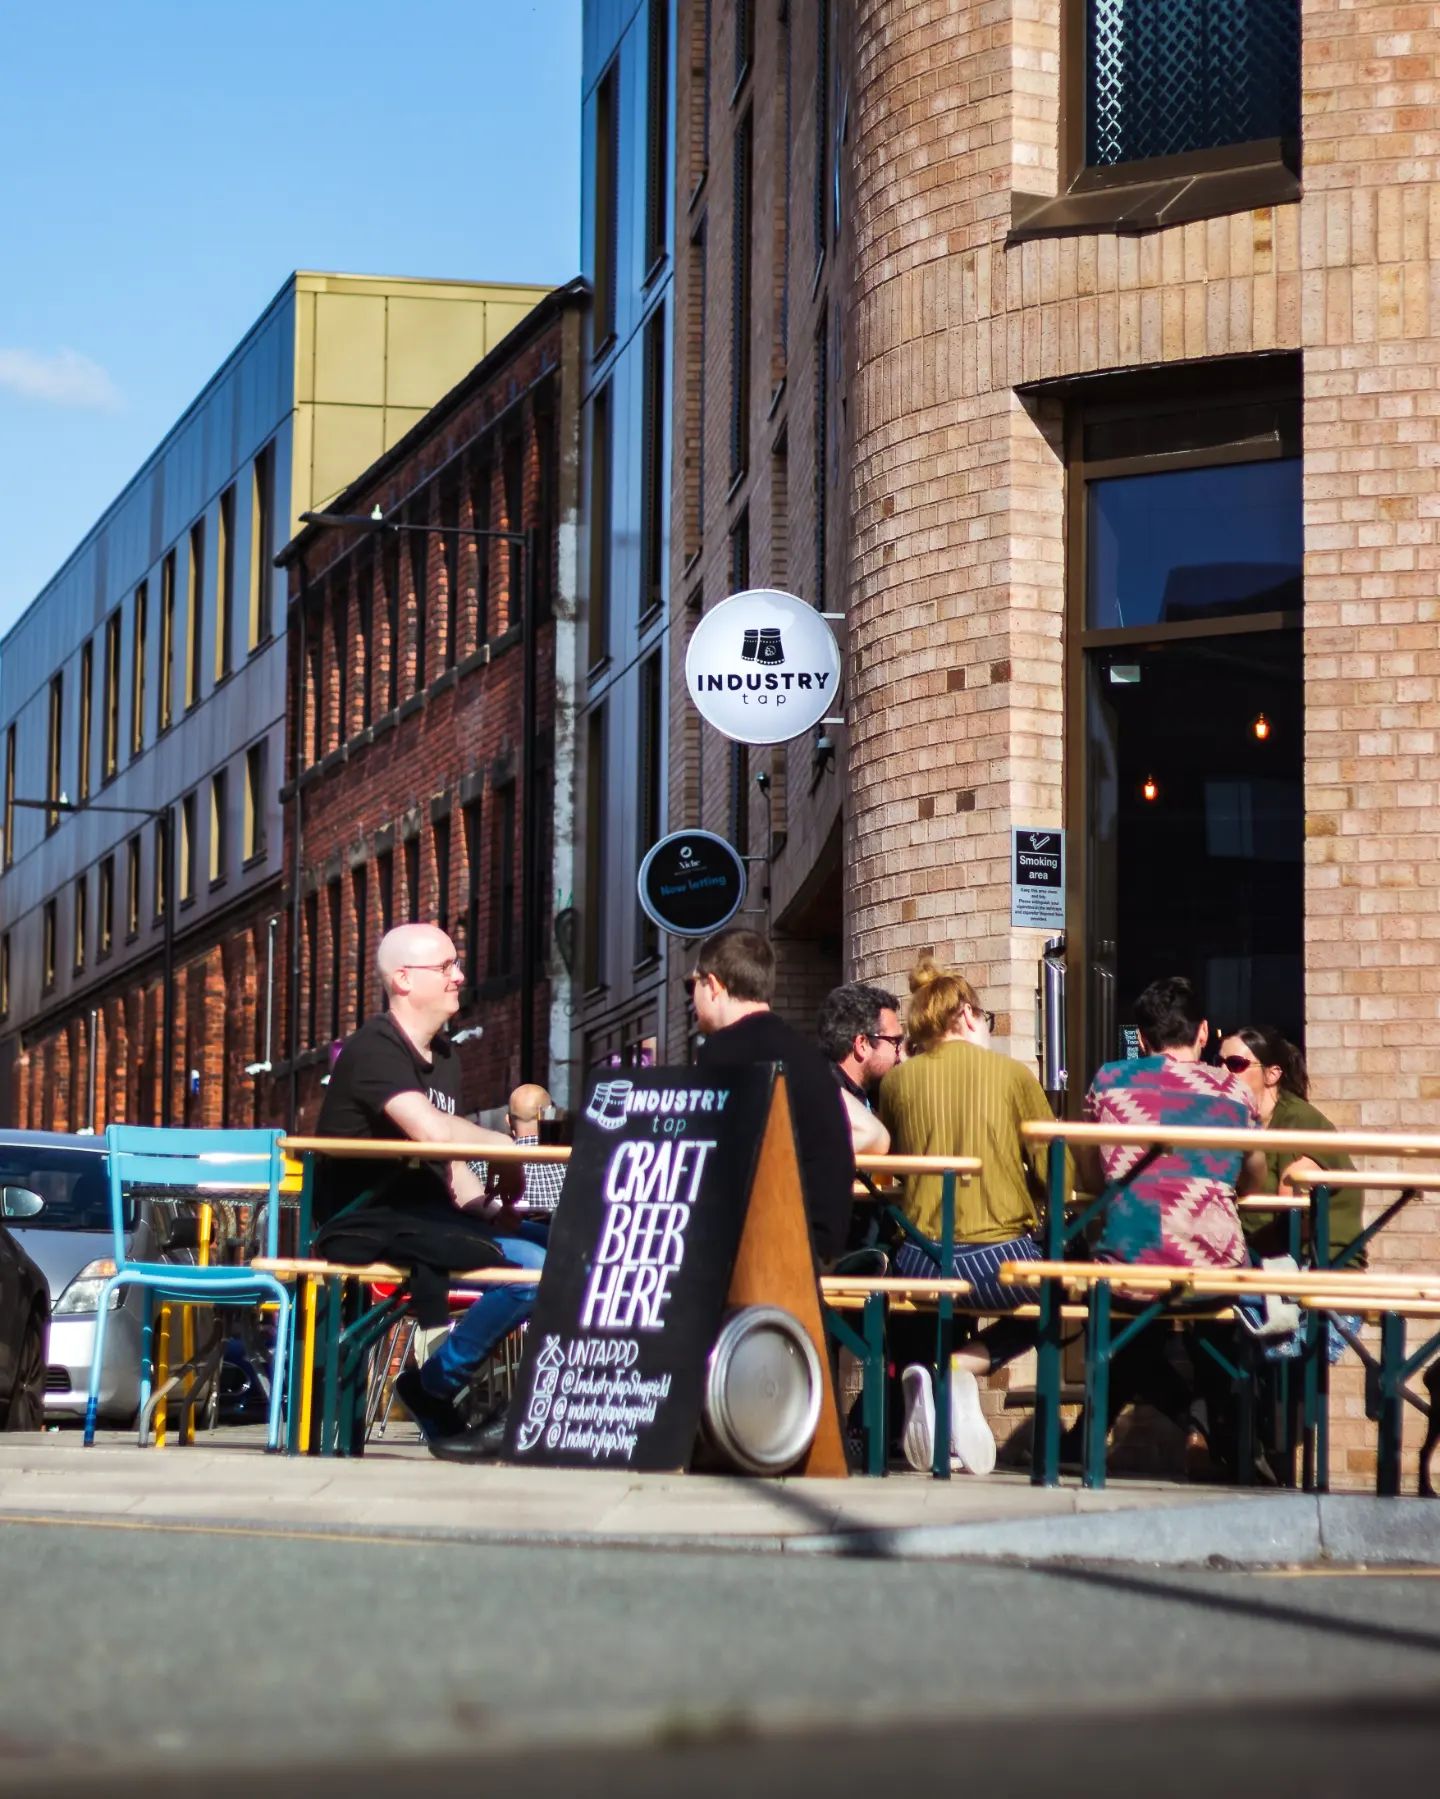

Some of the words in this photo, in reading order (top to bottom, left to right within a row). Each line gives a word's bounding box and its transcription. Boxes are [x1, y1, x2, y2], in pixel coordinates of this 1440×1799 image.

[698, 672, 830, 692] INDUSTRY
[742, 693, 787, 707] tap
[1019, 855, 1058, 869] Smoking
[1029, 871, 1049, 880] area
[660, 884, 687, 897] Now
[625, 1089, 730, 1113] INDUSTRY
[652, 1114, 687, 1138] tap
[605, 1140, 718, 1203] CRAFT
[596, 1202, 691, 1265] BEER
[581, 1264, 681, 1328] HERE
[567, 1339, 640, 1368] UNTAPPD
